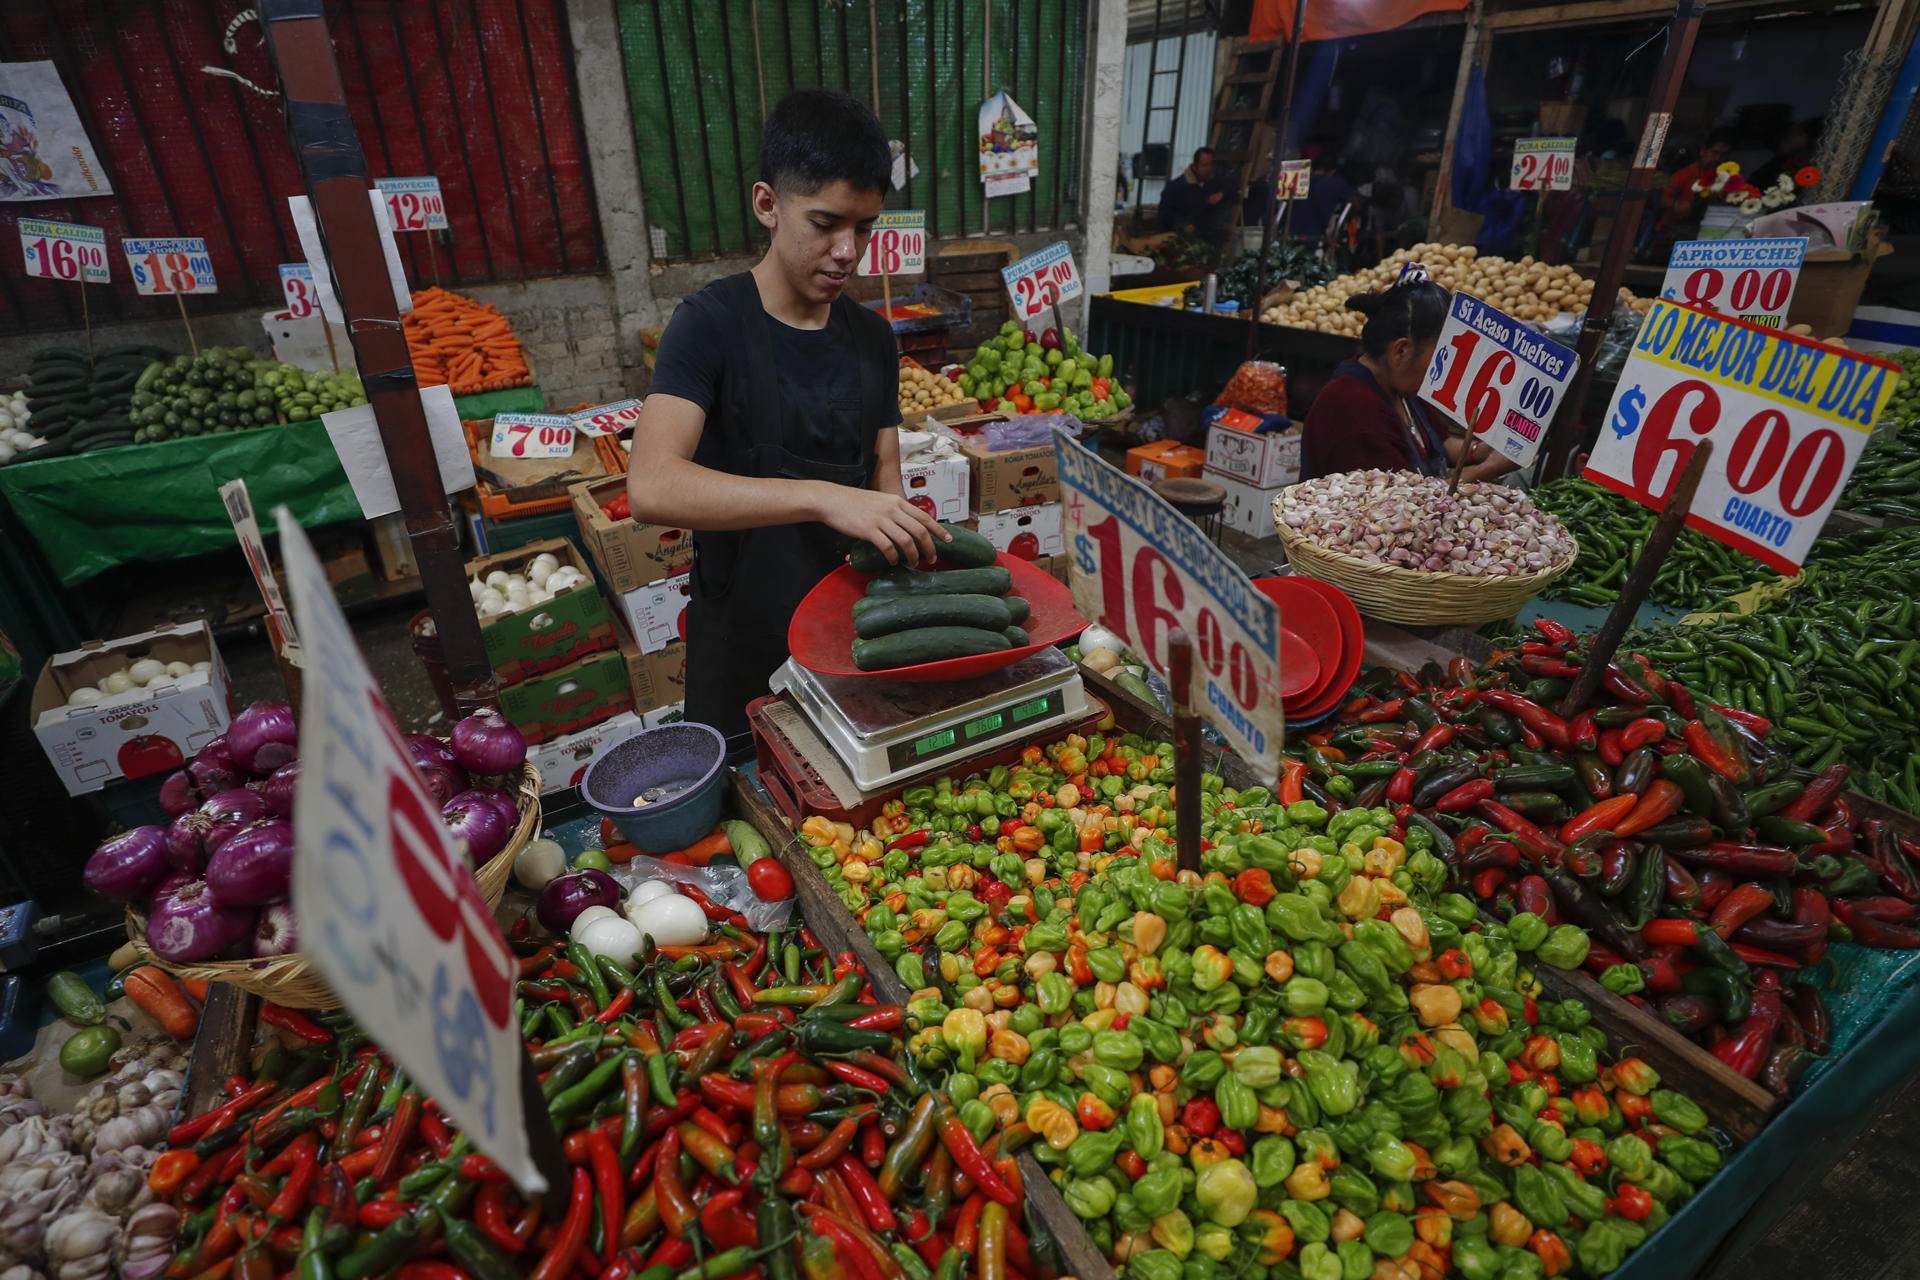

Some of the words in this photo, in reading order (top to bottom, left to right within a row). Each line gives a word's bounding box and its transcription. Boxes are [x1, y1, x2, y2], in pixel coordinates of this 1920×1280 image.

[886, 213, 923, 225] CALIDAD
[23, 223, 55, 235] PURA
[56, 227, 102, 241] CALIDAD
[1006, 263, 1031, 279] PURA
[1029, 243, 1068, 271] CALIDAD
[1677, 247, 1798, 261] APROVECHE
[1061, 280, 1079, 294] KILO
[1458, 299, 1475, 322] Si
[1472, 307, 1510, 342] Acaso
[1511, 327, 1565, 376] Vuelves
[1637, 303, 1680, 356] LO
[1669, 312, 1768, 386] MEJOR
[1758, 339, 1828, 404] DEL
[1504, 410, 1541, 442] CUARTO
[1722, 496, 1793, 547] CUARTO
[99, 703, 159, 725] TOMATOES
[108, 702, 144, 715] MEXICAN
[1207, 679, 1266, 755] CUARTO
[560, 737, 603, 756] TOMATOES
